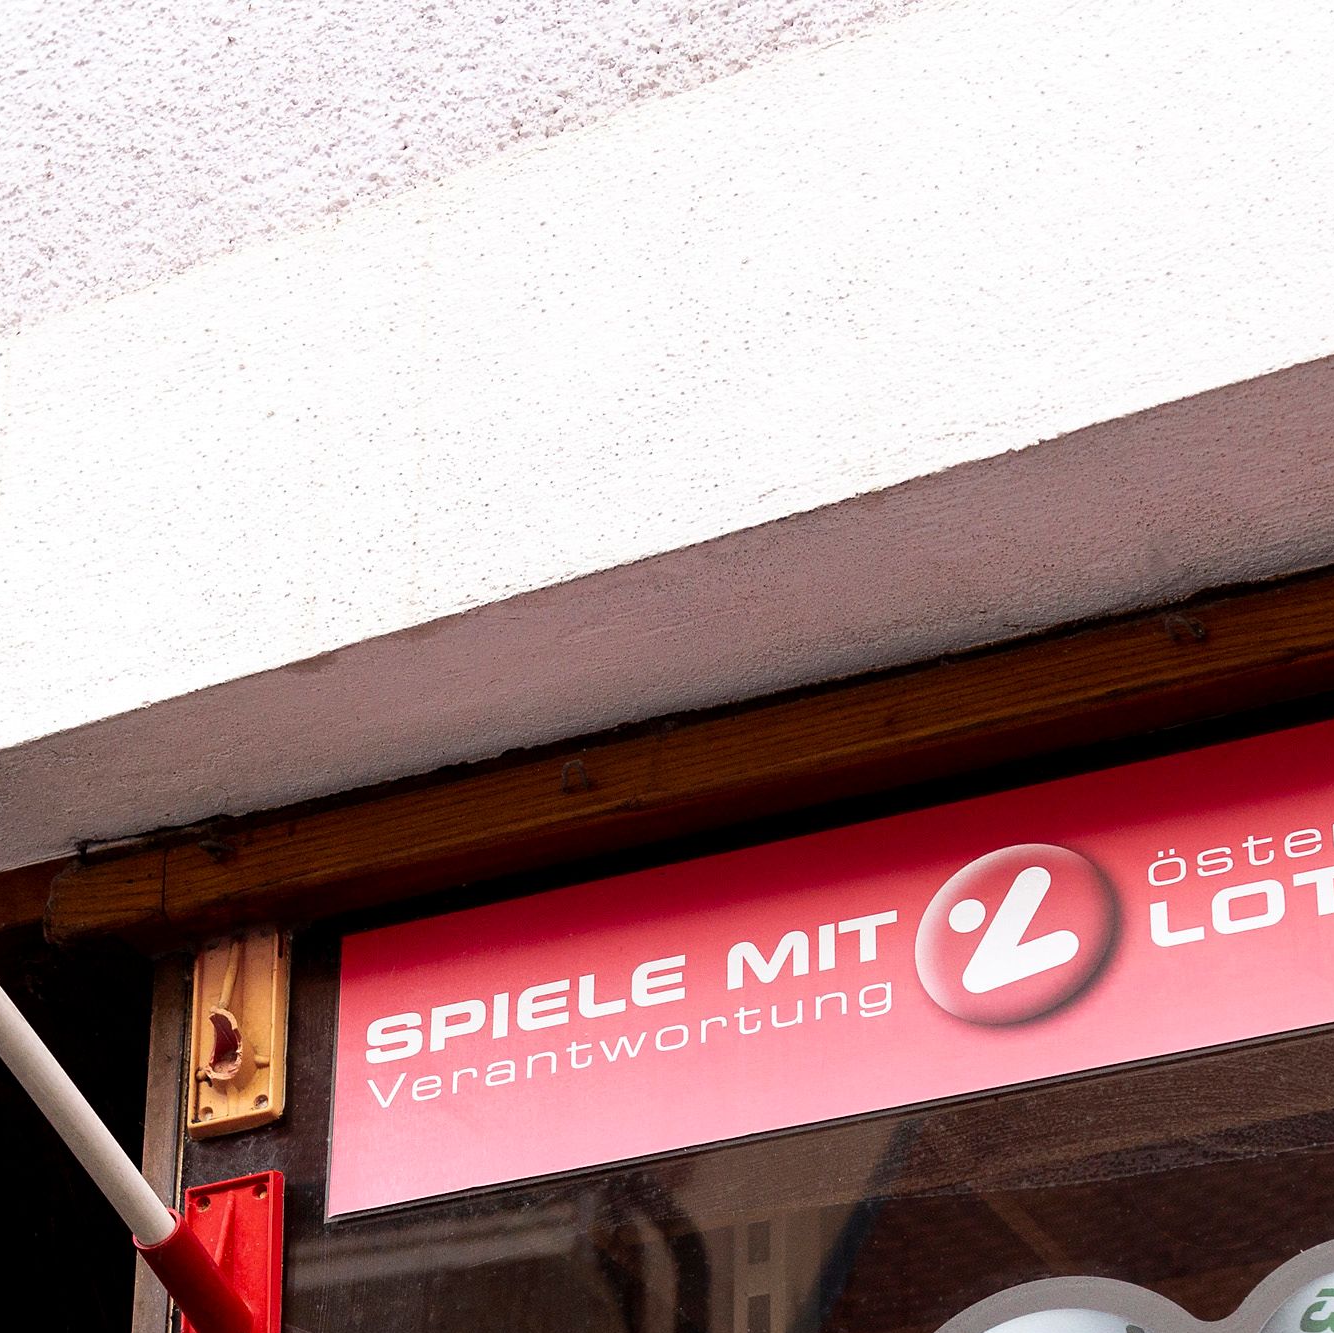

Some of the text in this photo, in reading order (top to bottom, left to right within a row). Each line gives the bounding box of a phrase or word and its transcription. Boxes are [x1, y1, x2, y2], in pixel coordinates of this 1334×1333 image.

[366, 910, 898, 1064] SPIELE MIT
[367, 980, 893, 1109] Verantwortung
